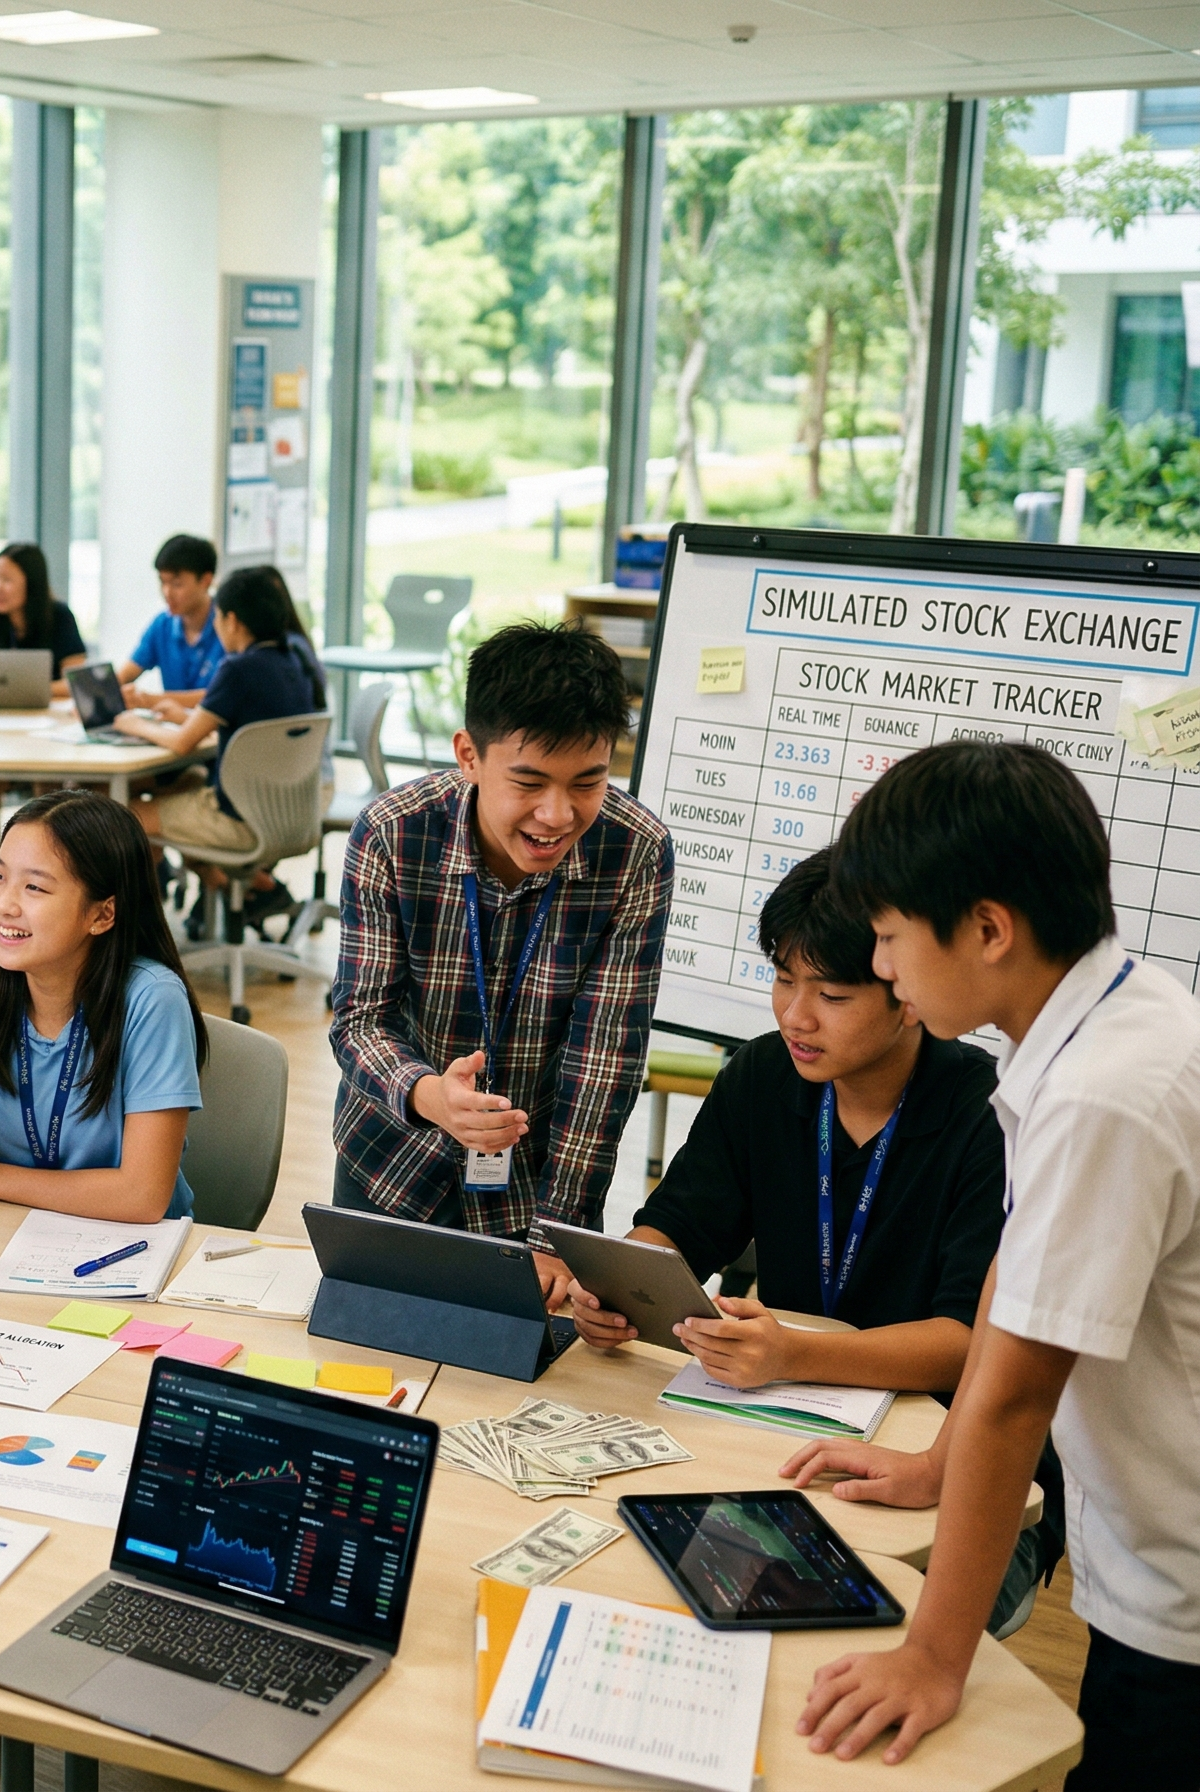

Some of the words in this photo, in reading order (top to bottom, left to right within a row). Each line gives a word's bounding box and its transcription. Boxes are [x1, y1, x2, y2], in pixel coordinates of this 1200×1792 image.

[761, 586, 908, 629] SIMULATED
[921, 599, 1011, 638] STOCK
[1024, 608, 1183, 655] EXCHANGE
[798, 661, 871, 695] STOCK
[881, 670, 980, 707] MARKET
[991, 681, 1103, 721] TRACKER
[777, 706, 808, 724] REAL
[812, 710, 842, 728] TIME
[774, 741, 831, 766] 23.363
[695, 769, 727, 788] TUES
[669, 802, 746, 828] WEDNESDAY
[771, 818, 805, 839] 300
